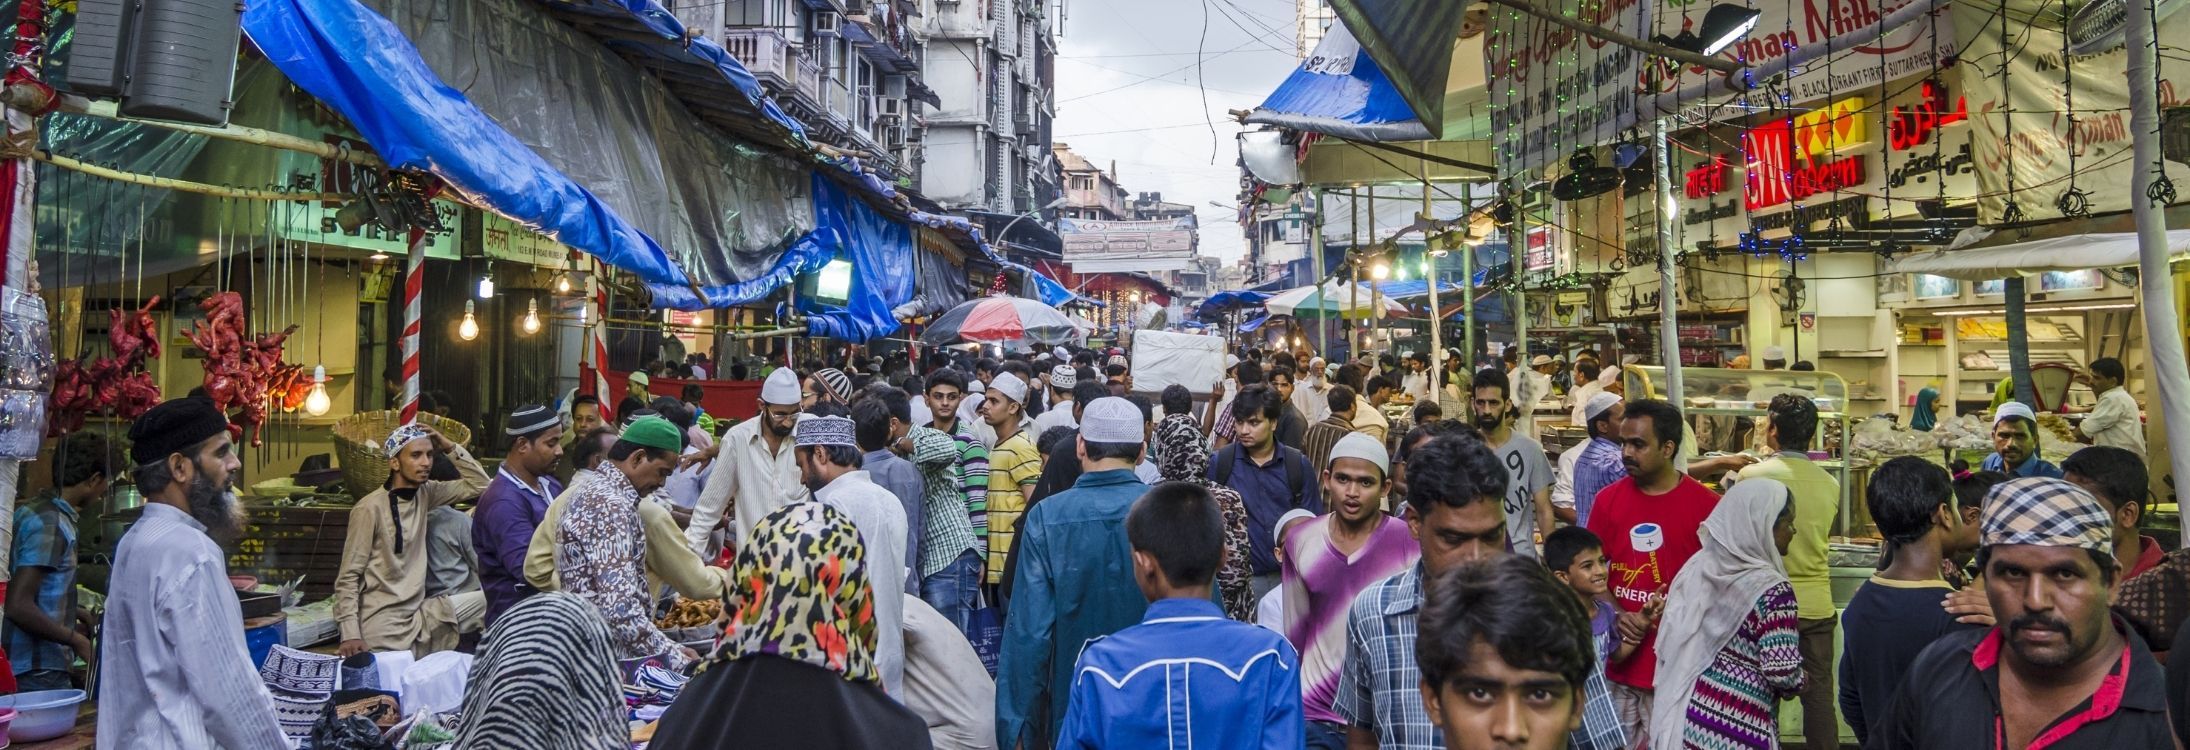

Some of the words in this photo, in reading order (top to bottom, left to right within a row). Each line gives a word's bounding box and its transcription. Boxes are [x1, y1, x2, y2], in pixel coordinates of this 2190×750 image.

[1801, 76, 1827, 97] BLACK
[1829, 67, 1863, 92] CURRANT
[1864, 66, 1884, 83] FIRN
[1745, 130, 1866, 207] Modern
[1611, 562, 1629, 572] FULL
[1649, 550, 1662, 583] BATTERY
